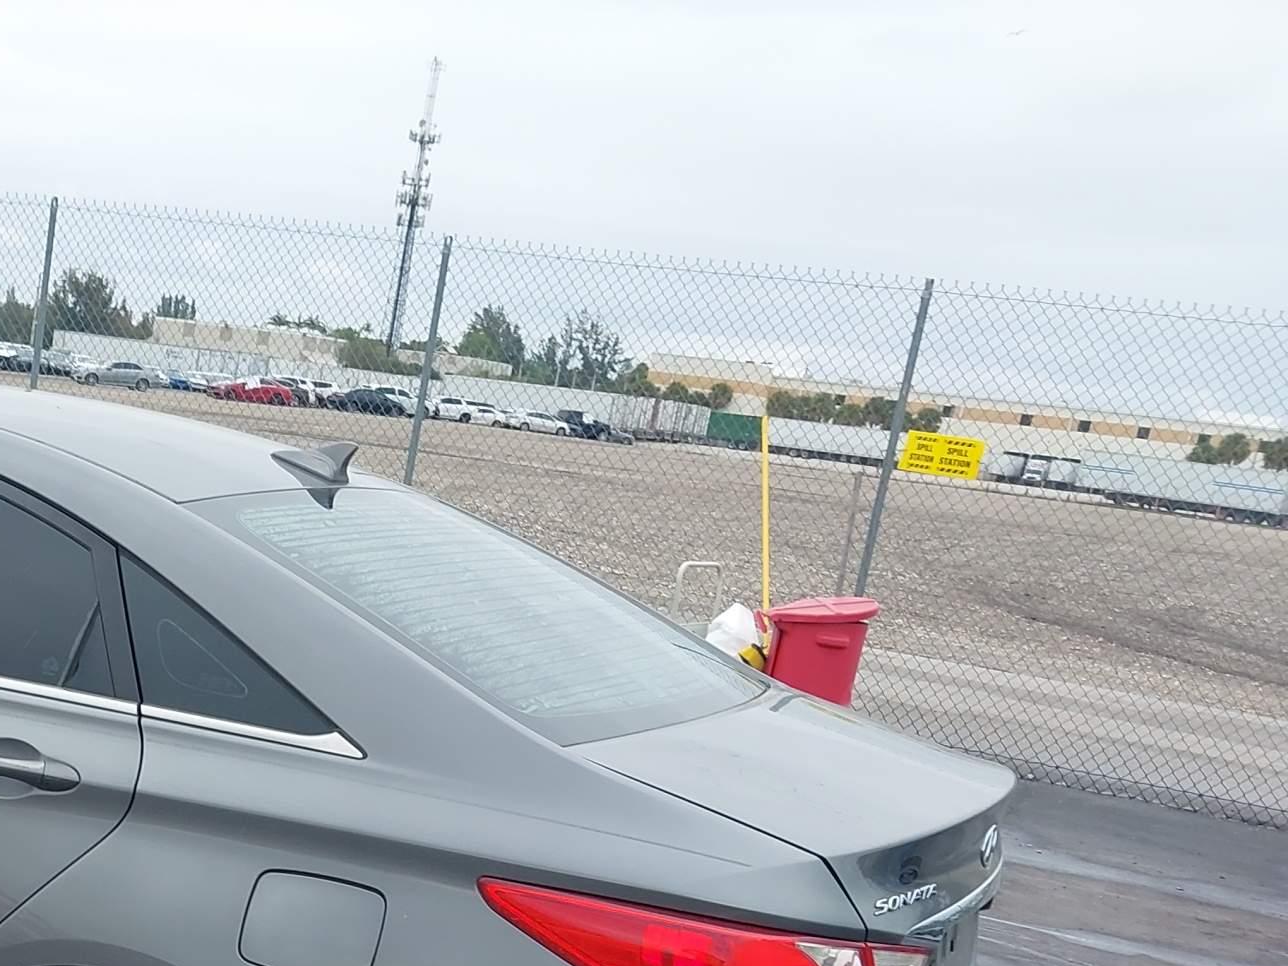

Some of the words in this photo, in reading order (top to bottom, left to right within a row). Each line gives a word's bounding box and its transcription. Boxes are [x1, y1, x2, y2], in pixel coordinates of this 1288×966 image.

[916, 443, 933, 453] SPILL
[946, 447, 969, 458] SPILL
[908, 453, 935, 463] STATION
[938, 456, 971, 469] STATION
